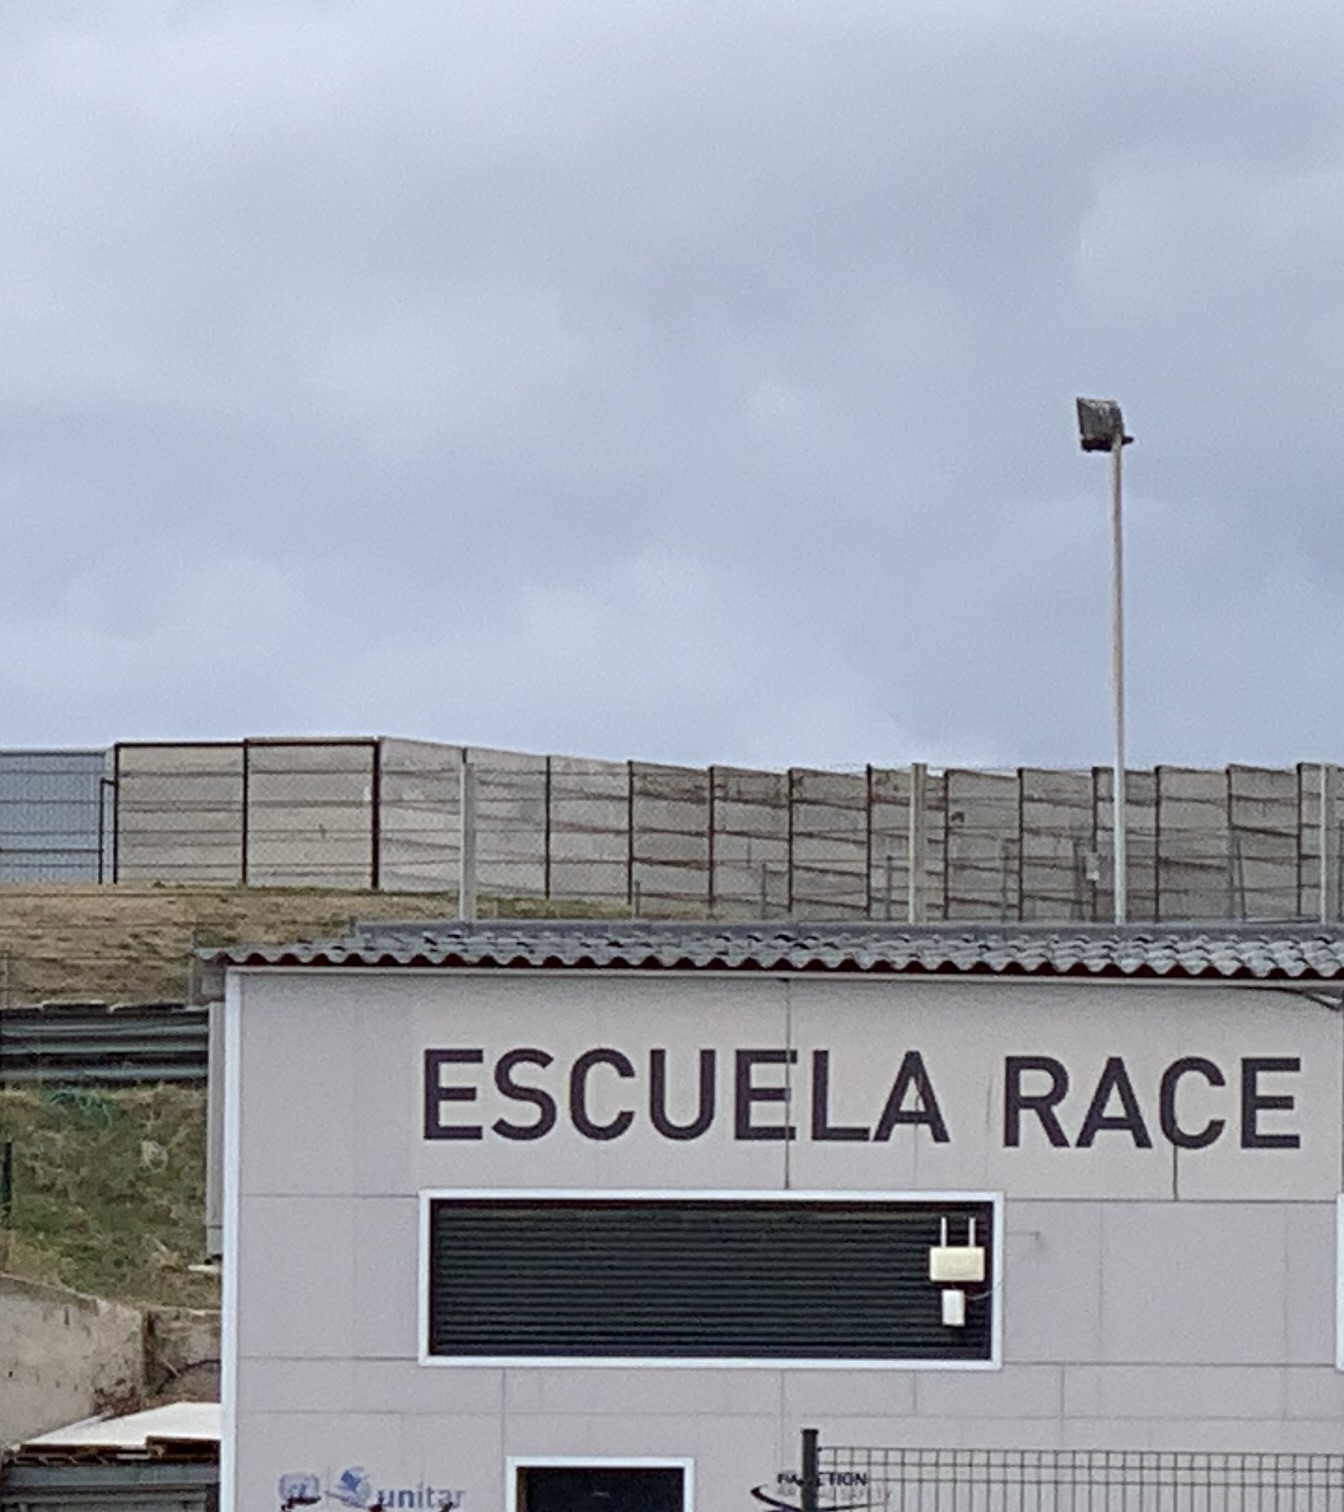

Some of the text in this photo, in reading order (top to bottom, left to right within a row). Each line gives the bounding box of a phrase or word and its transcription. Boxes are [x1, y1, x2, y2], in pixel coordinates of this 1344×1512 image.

[423, 1048, 950, 1142] ESCUELA
[1003, 1055, 1301, 1149] RACE
[377, 1481, 465, 1508] unitar
